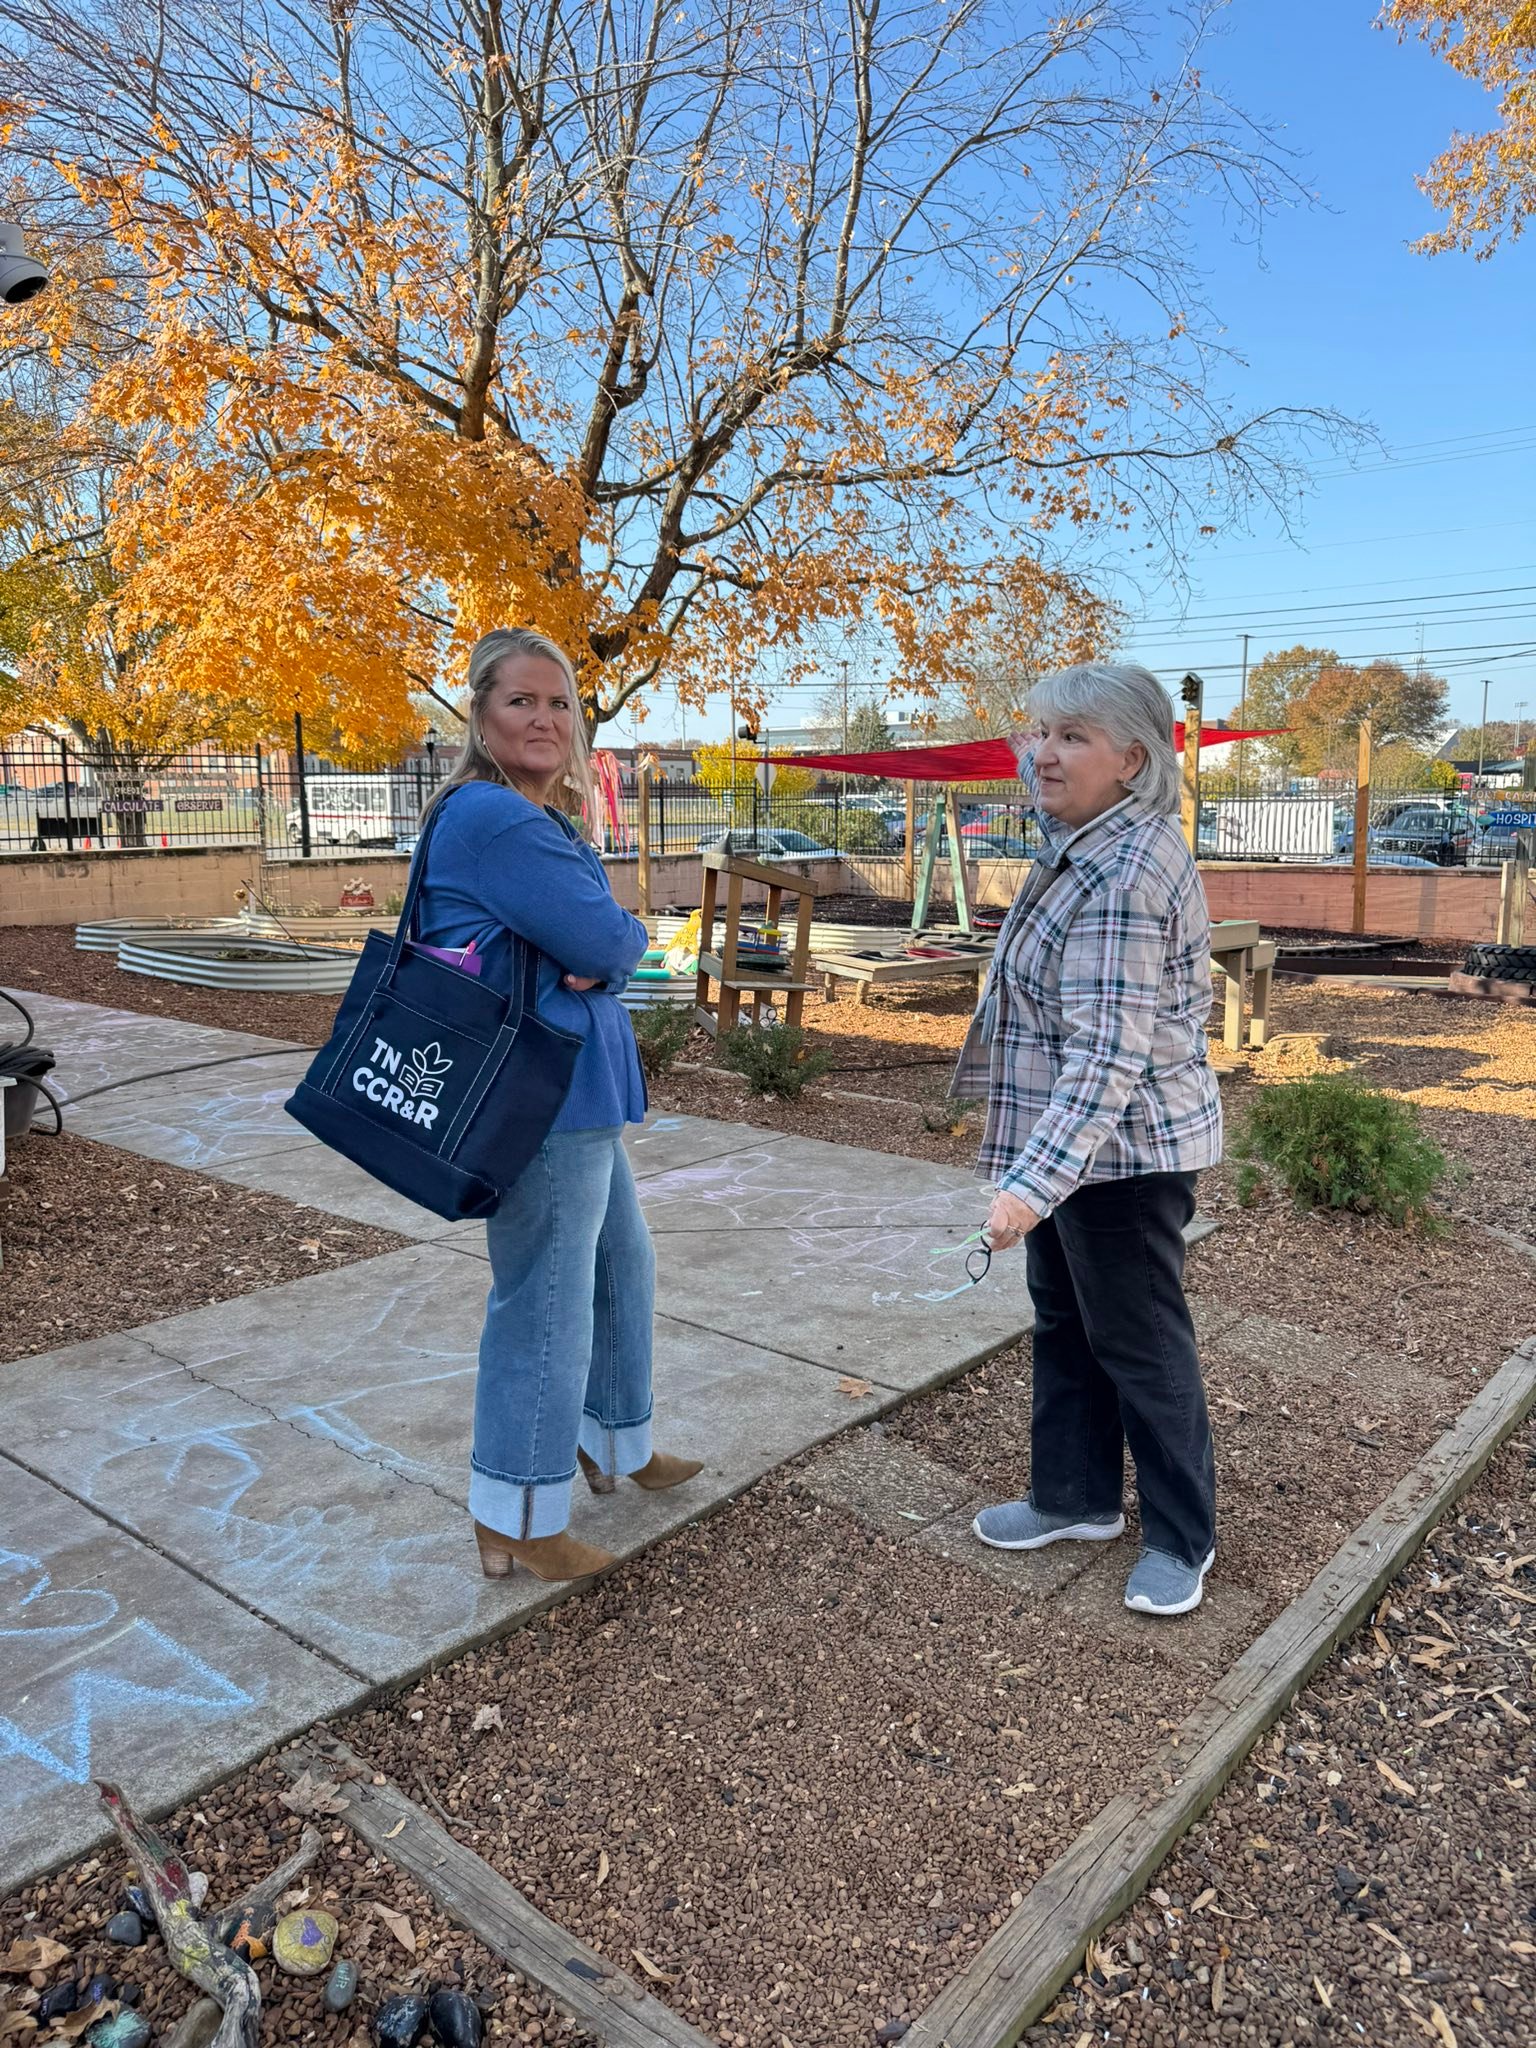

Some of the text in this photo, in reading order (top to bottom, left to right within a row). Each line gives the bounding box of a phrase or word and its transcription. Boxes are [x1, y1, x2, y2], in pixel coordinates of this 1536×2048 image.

[1505, 791, 1536, 801] CAM
[104, 801, 160, 812] CALCULATE
[177, 801, 221, 811] OBSERVE
[370, 1037, 402, 1075] TN
[353, 1067, 439, 1130] CCR&R
